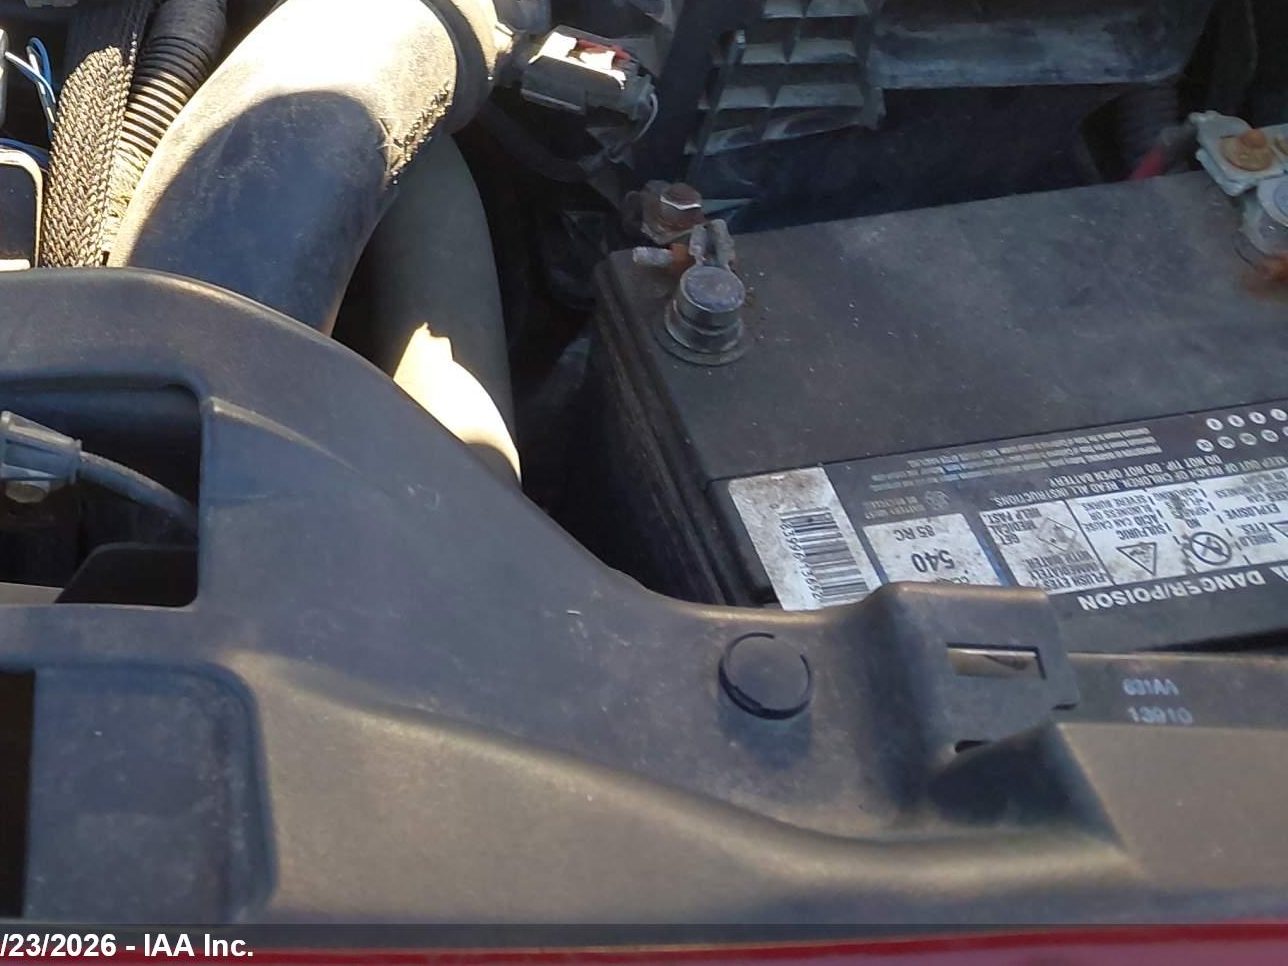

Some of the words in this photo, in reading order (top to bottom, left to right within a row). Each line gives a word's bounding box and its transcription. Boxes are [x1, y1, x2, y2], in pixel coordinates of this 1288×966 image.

[1184, 456, 1207, 468] NOT
[1096, 468, 1123, 481] OPEN
[1123, 464, 1144, 476] NOT
[1072, 484, 1090, 496] ALL
[1092, 480, 1120, 493] READ
[1222, 503, 1281, 520] EXPLOSIVE
[1112, 517, 1133, 528] CAN
[1135, 514, 1160, 526] ACID
[893, 528, 916, 542] RC
[917, 524, 936, 539] 85
[1116, 524, 1167, 540] SULFURIC
[1001, 533, 1021, 546] GET
[911, 549, 955, 573] 540
[1043, 577, 1072, 590] EYES
[1071, 572, 1106, 587] FLUSH
[1076, 569, 1267, 611] DANGER/POISON
